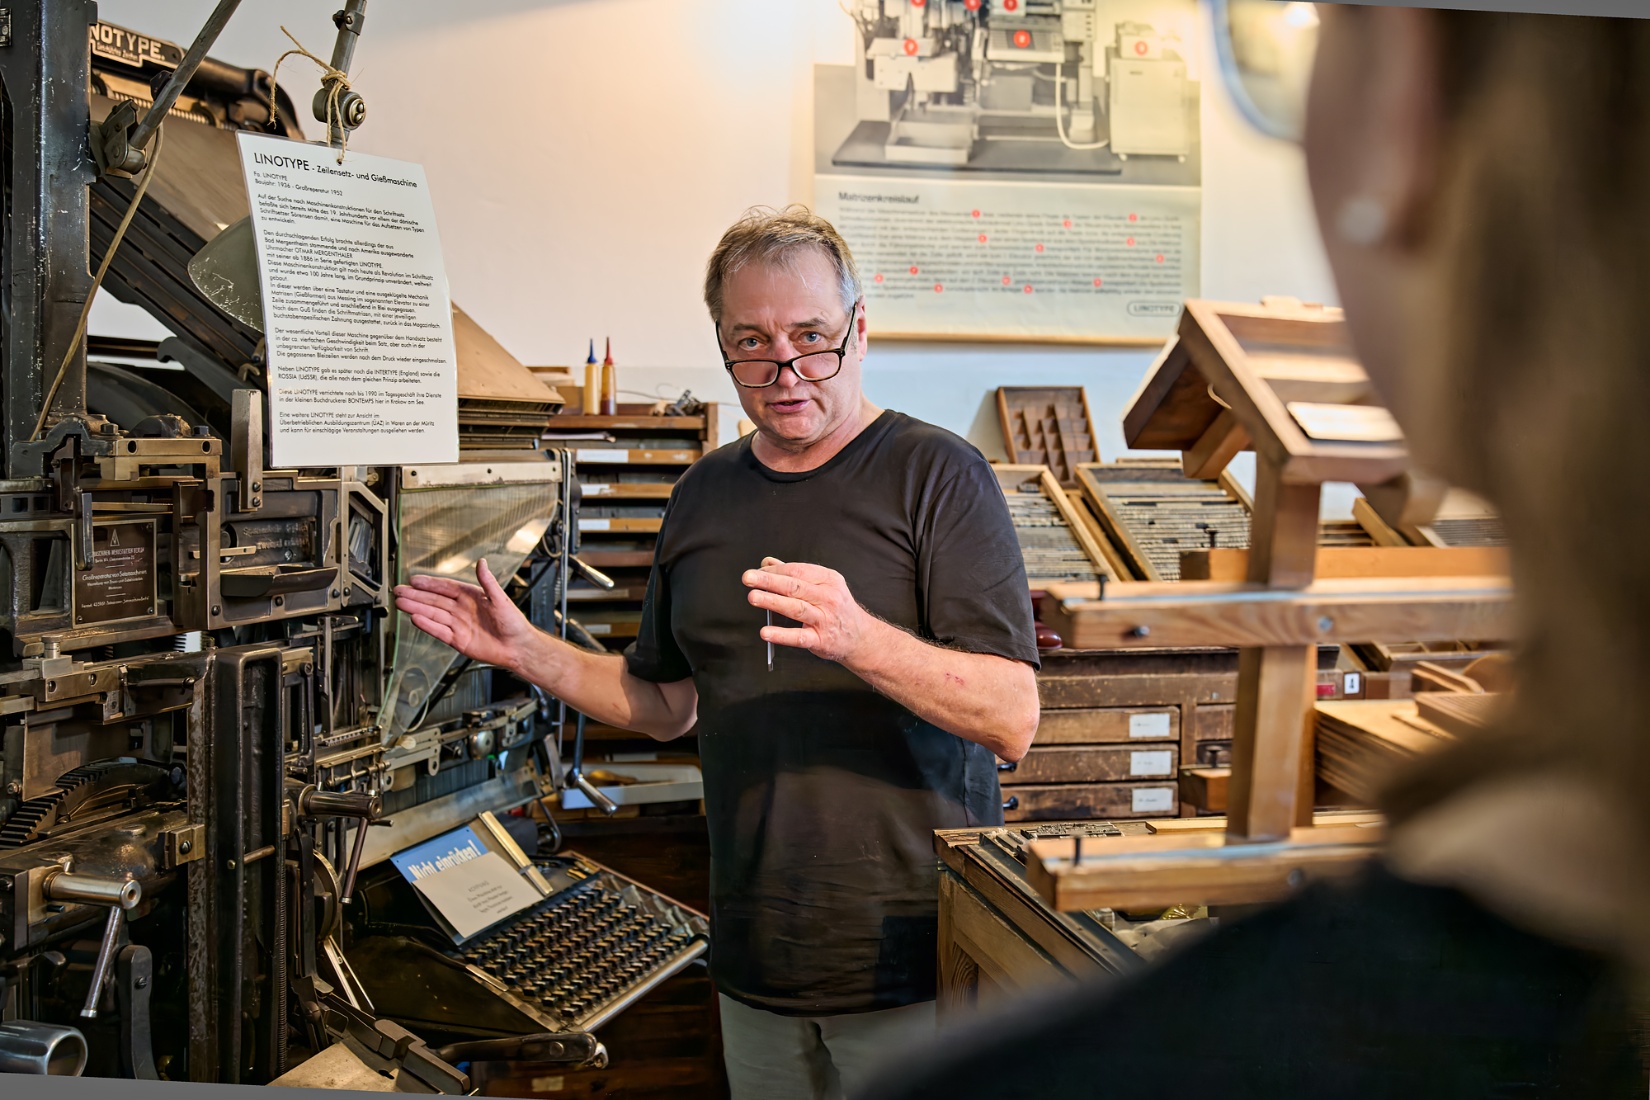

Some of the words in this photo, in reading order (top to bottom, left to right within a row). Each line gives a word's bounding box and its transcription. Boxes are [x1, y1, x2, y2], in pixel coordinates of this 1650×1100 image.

[254, 152, 310, 171] LINOTYPE
[316, 165, 354, 178] Zeilensetz-
[356, 173, 369, 181] und
[371, 173, 417, 188] Gießmaschine
[408, 860, 438, 880] Nicht
